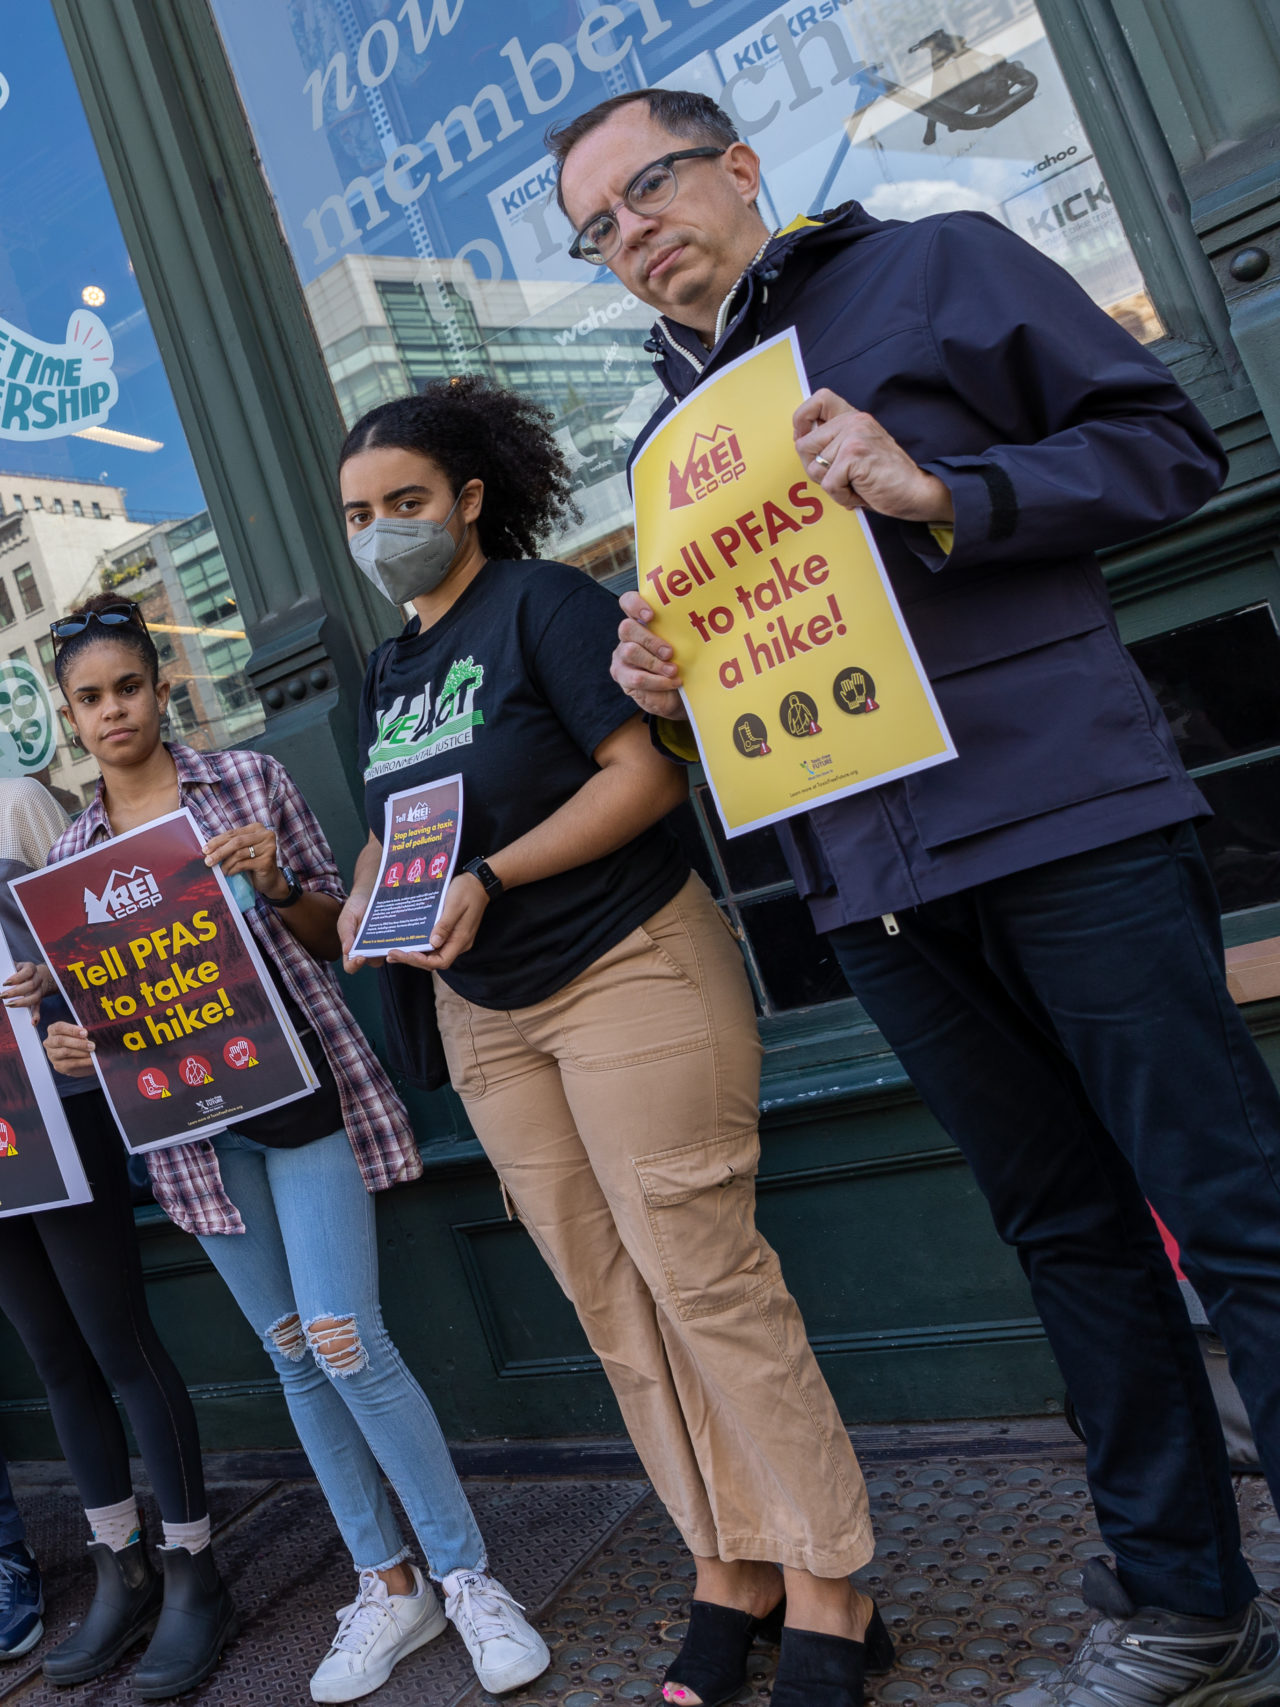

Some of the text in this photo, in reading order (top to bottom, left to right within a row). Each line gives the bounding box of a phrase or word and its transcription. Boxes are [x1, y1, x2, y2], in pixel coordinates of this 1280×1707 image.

[302, 0, 464, 130] now
[1021, 145, 1077, 178] wahoo
[501, 164, 559, 215] KICK
[552, 292, 639, 346] wahoo
[693, 434, 744, 488] REI
[646, 481, 824, 606] Tell PFAS
[690, 554, 830, 643] to take
[718, 593, 848, 690] a hike!
[433, 731, 472, 758] JUSTICE
[392, 832, 443, 851] trail of pollution!
[394, 832, 407, 841] Stop
[408, 825, 431, 837] leaving
[437, 819, 453, 829] toxic
[110, 873, 159, 911] REI
[67, 910, 218, 990] Tell PFAS
[100, 960, 220, 1021] to take
[122, 988, 235, 1052] a hike!
